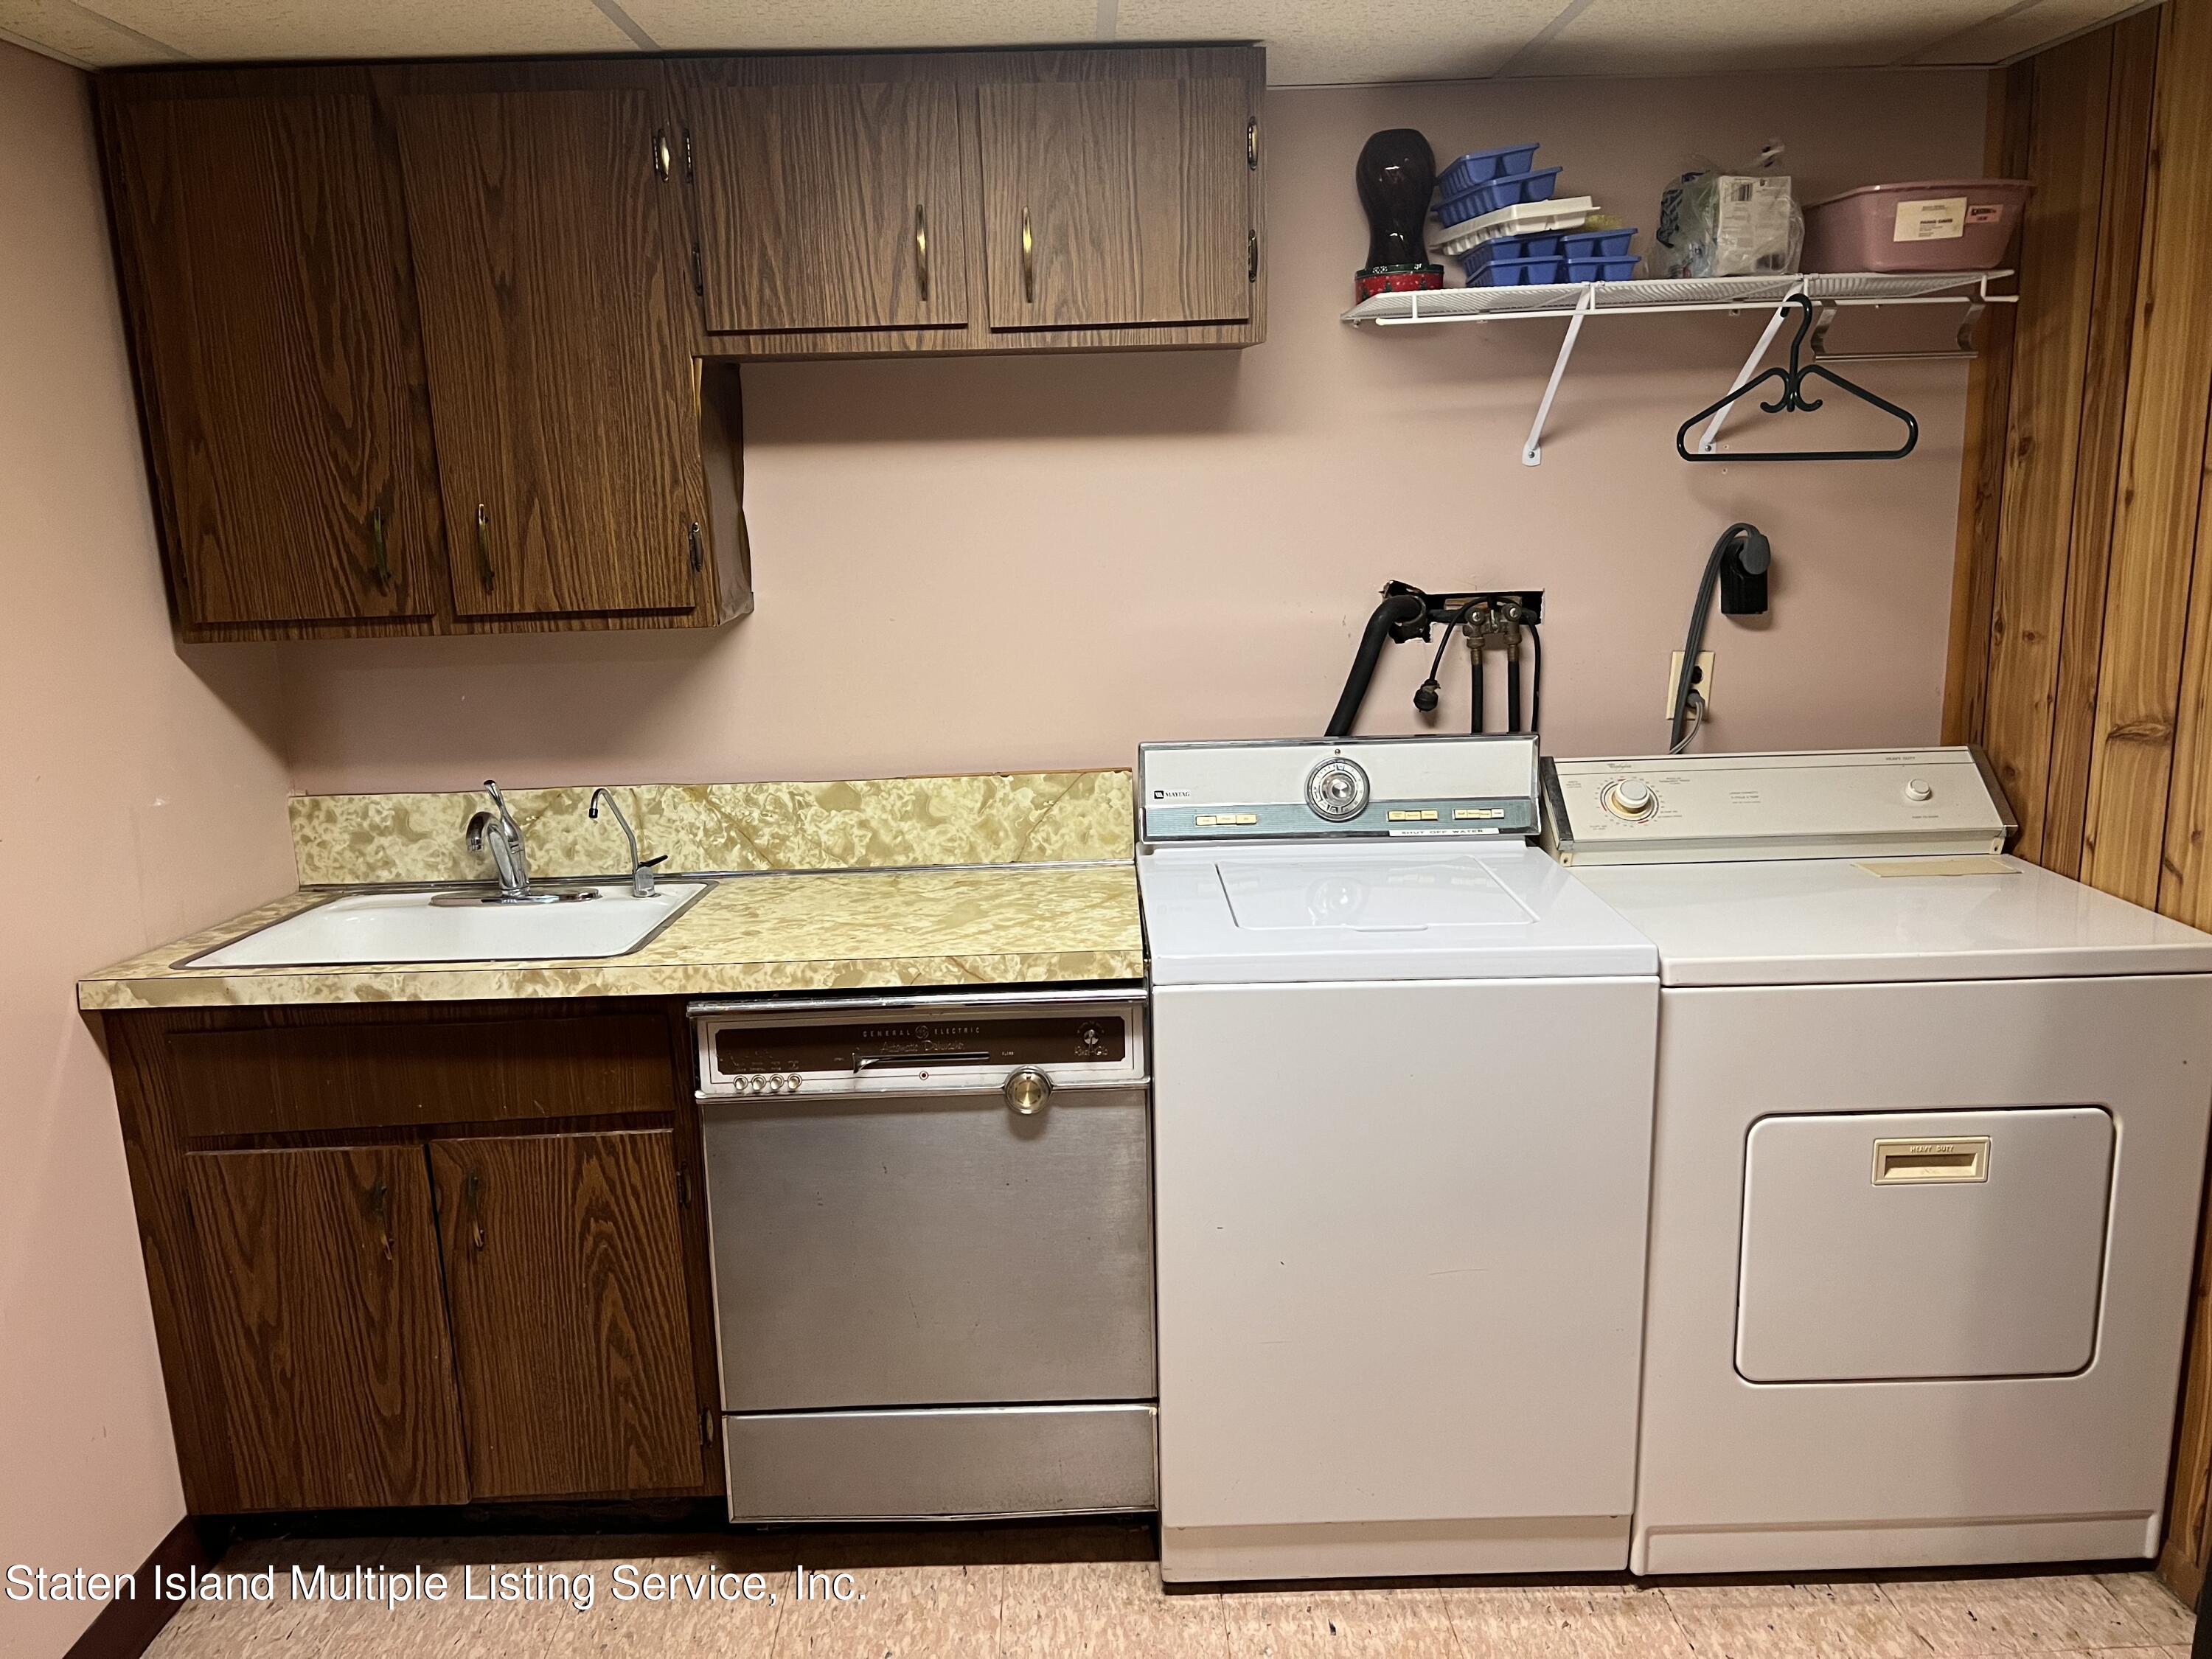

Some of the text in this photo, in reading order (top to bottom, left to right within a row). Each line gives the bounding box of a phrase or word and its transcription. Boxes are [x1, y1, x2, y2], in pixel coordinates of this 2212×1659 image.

[863, 1026, 981, 1037] GENERAL ELECTRIC
[1910, 1145, 1932, 1153] HEAVY
